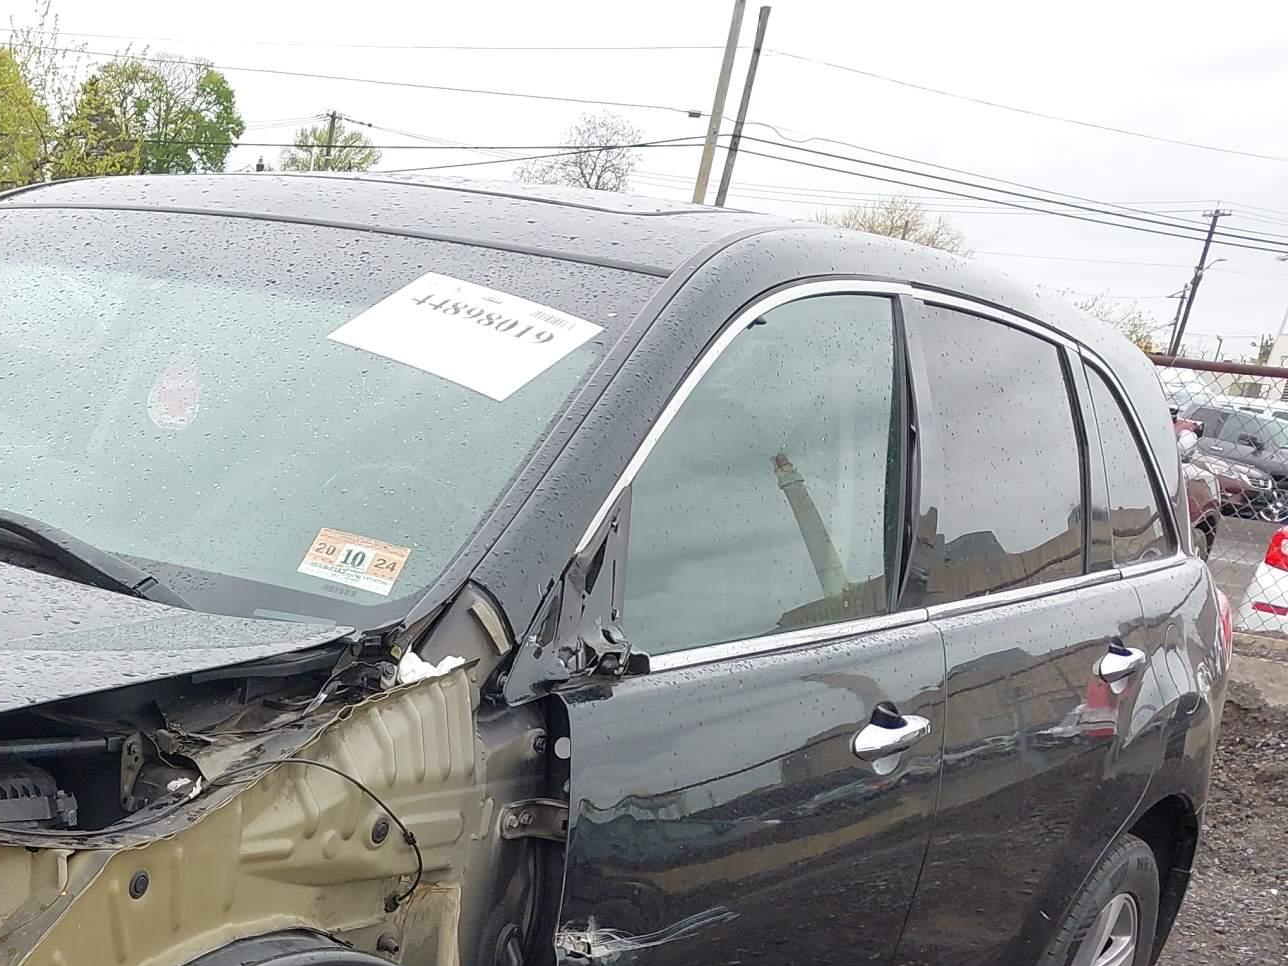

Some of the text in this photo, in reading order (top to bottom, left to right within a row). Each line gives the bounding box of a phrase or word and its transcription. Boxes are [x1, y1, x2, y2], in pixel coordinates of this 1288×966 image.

[412, 294, 554, 343] 44898019
[315, 542, 337, 556] 20
[340, 548, 366, 568] 10
[374, 558, 397, 572] 24
